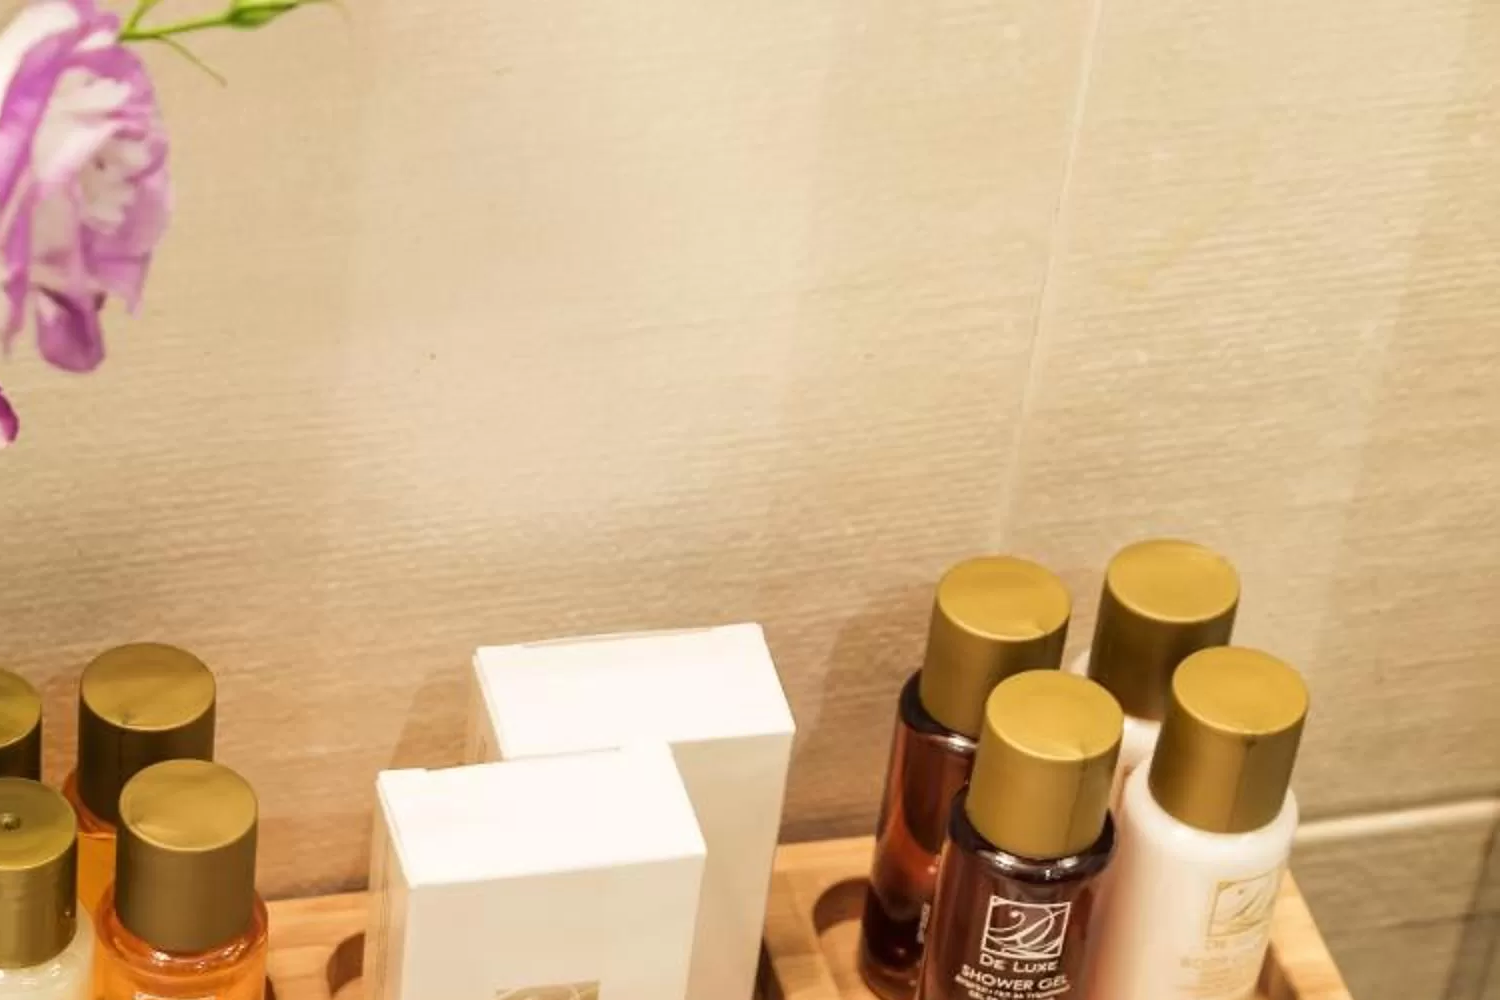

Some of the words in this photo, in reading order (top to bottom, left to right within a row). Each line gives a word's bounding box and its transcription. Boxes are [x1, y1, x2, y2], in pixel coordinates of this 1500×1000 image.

[980, 953, 1007, 971] DE
[1012, 960, 1058, 974] LUXE
[961, 963, 1035, 991] SHOWER
[1037, 974, 1067, 990] GEL
